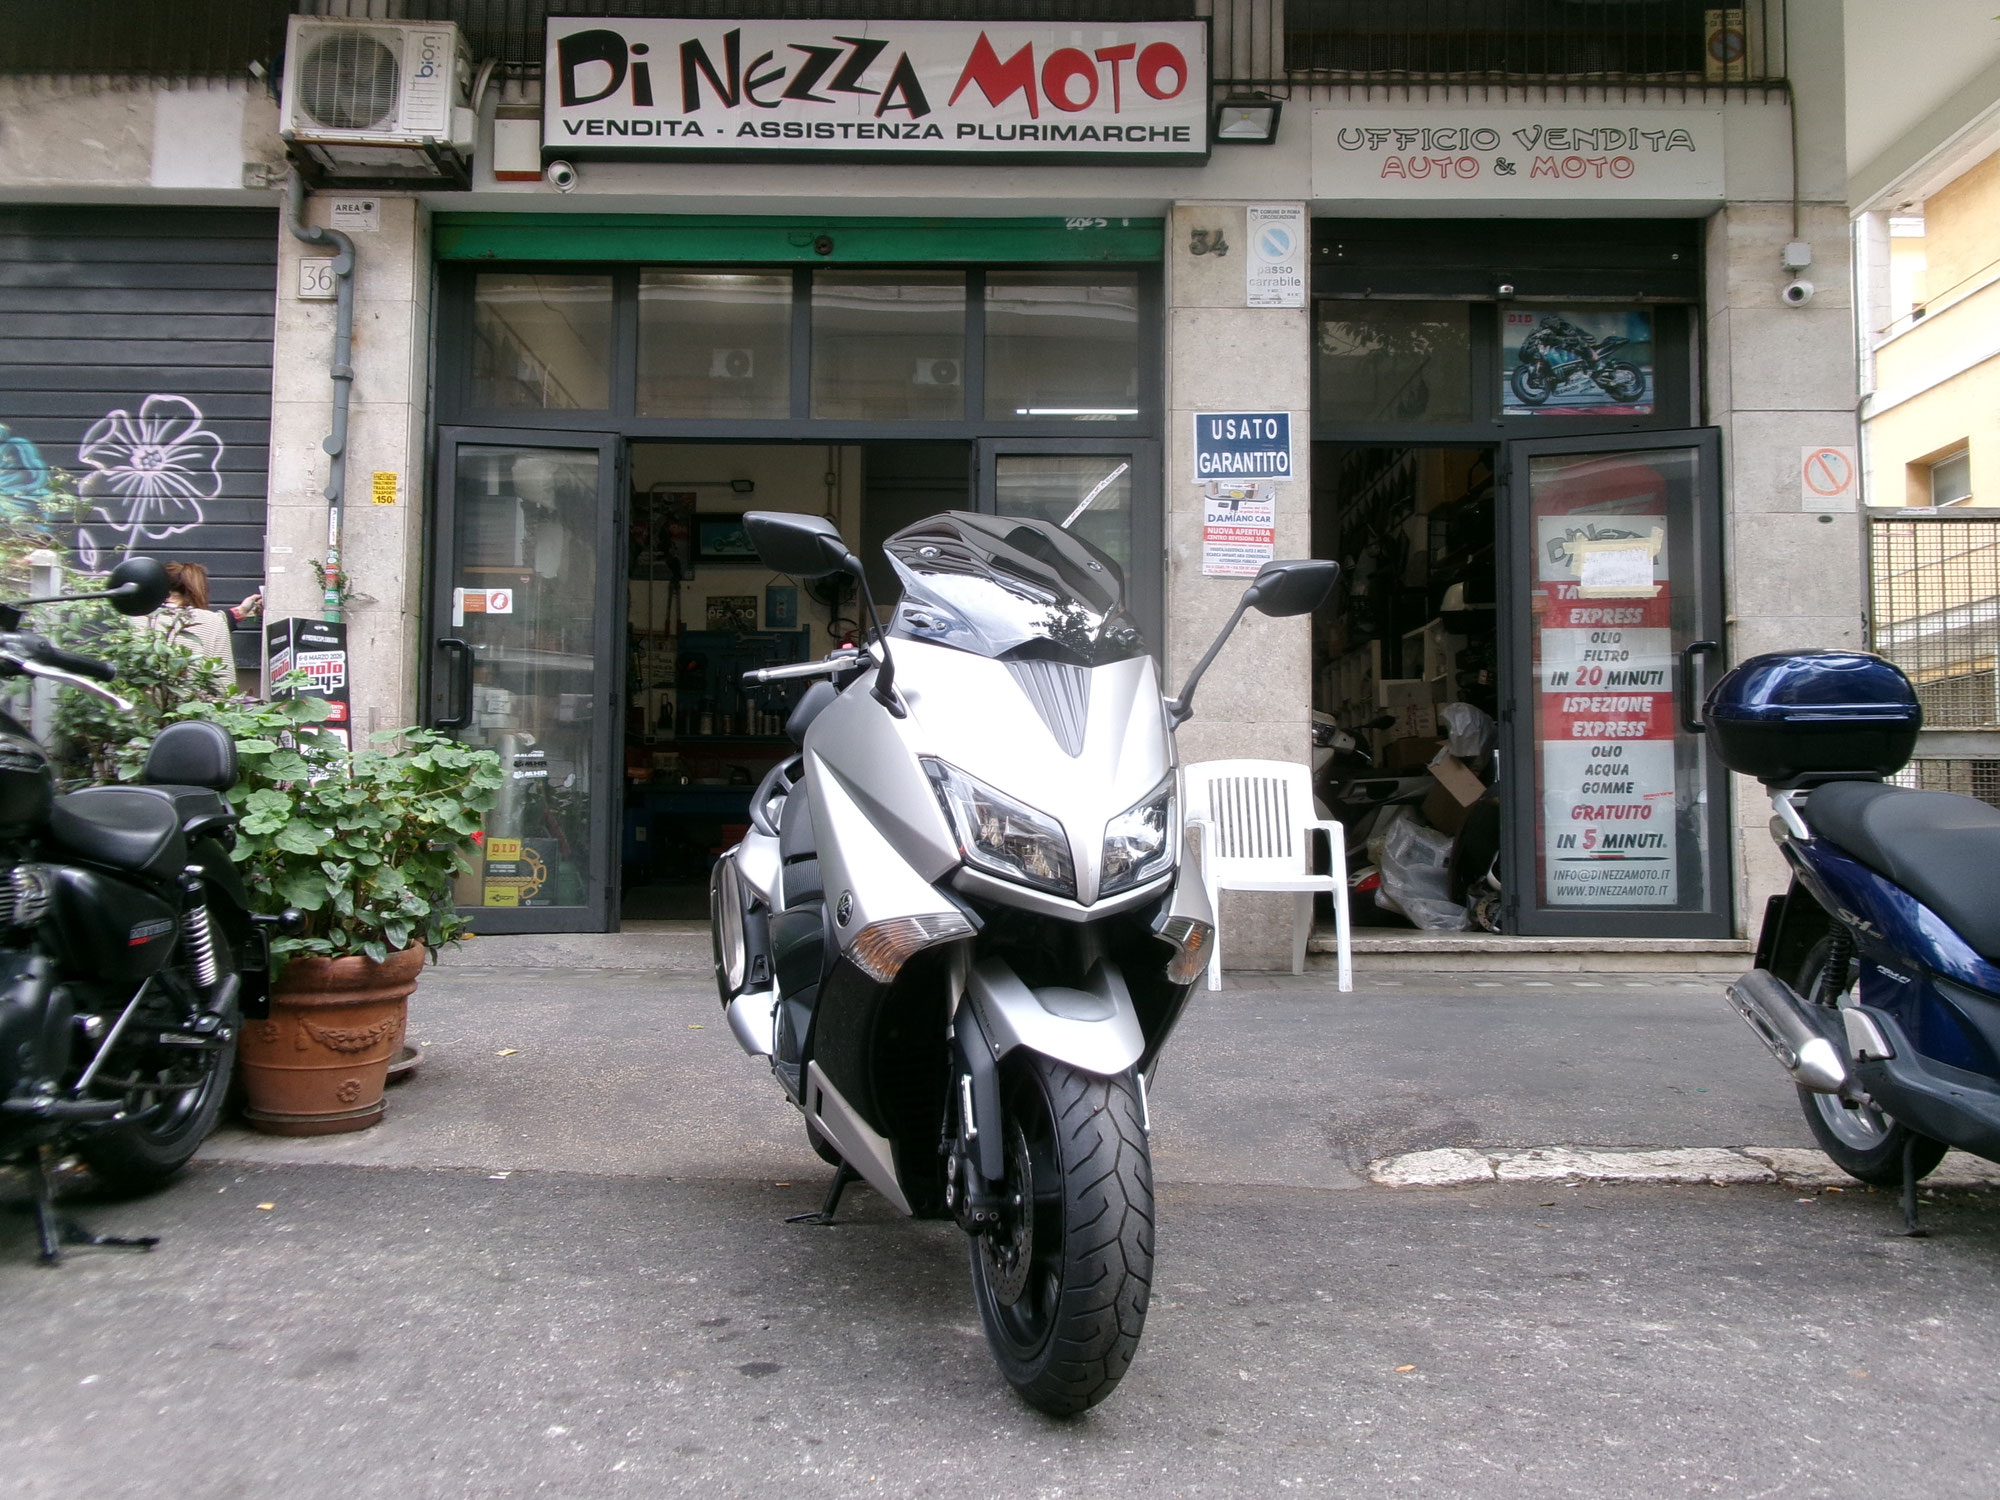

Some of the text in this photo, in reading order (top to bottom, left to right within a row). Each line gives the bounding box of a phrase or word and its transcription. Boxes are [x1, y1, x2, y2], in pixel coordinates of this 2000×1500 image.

[947, 30, 1188, 120] MOTO
[562, 119, 705, 137] VENDITA
[736, 121, 944, 140] ASSISTENZA
[957, 123, 1191, 142] PLURIMARCHE
[1337, 123, 1696, 152] UFFICIO VENDITA
[1381, 155, 1635, 179] AUTO & MOTO
[335, 204, 361, 212] AREA
[1189, 229, 1229, 257] 34
[302, 265, 332, 291] 36
[1257, 265, 1293, 276] passo
[1249, 276, 1301, 287] carrabile
[1212, 418, 1278, 440] USATO
[1199, 451, 1289, 473] GARANTITO
[1207, 513, 1271, 523] DAMIANO CAR
[1207, 527, 1271, 536] NUOVA APERTURA
[1569, 608, 1644, 624] EXPRESS
[1591, 631, 1622, 644] OLIO
[1583, 650, 1630, 662] FILTRO
[1550, 665, 1664, 686] IN 20 MINUTI
[1562, 696, 1654, 713] ISPEZIONE
[1571, 721, 1647, 738] EXPRESS
[1591, 745, 1623, 758] OLIO
[1585, 764, 1629, 776] ACQUA
[1582, 782, 1635, 794] GOMME
[1571, 804, 1652, 821] GRATUITO
[1556, 833, 1577, 849] IN
[1582, 828, 1597, 850] 5
[1553, 869, 1671, 882] INFO@DINEZZAMOTO.IT
[1557, 885, 1668, 897] WWW.DINEZZAMOTO.IT
